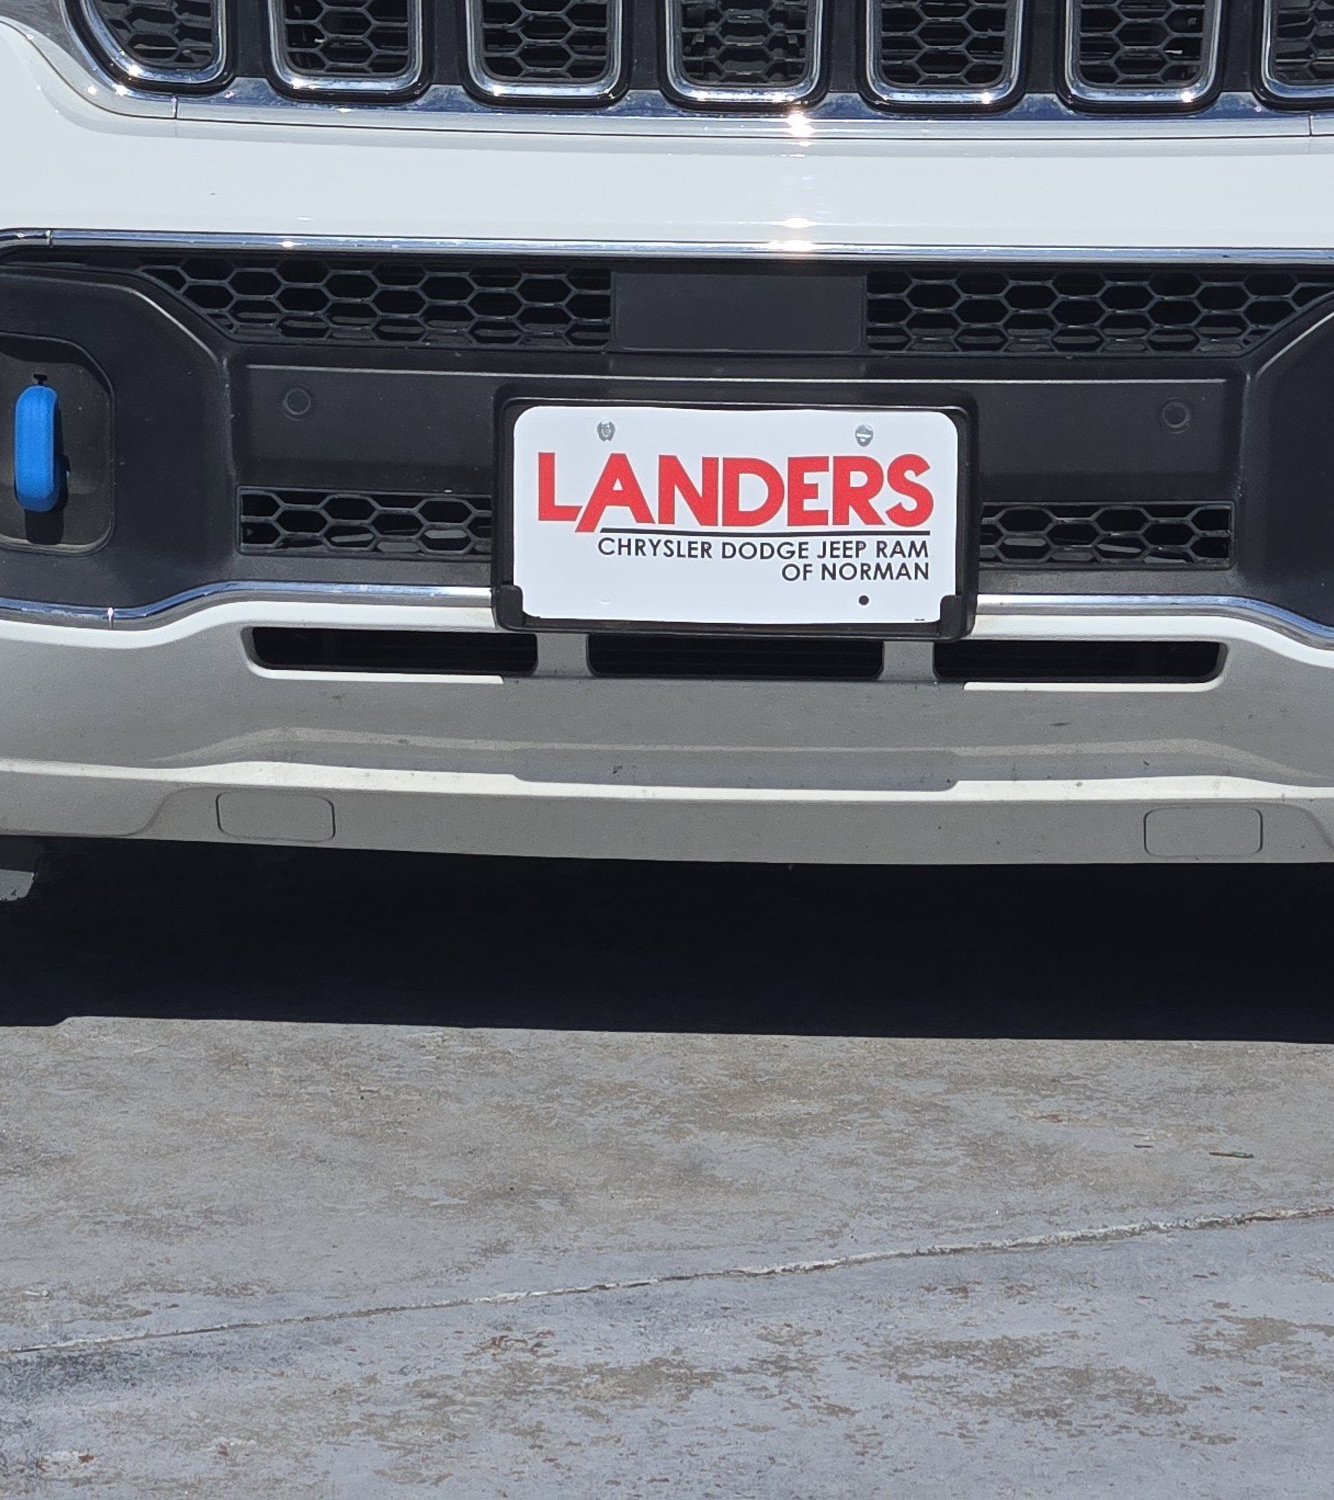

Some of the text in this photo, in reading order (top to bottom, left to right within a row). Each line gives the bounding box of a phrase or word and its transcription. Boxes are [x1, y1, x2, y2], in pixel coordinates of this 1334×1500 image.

[537, 452, 934, 533] LANDERS
[597, 537, 929, 560] CHRYSLER DODGE JEEP RAM
[781, 562, 930, 582] OF NORMAN
